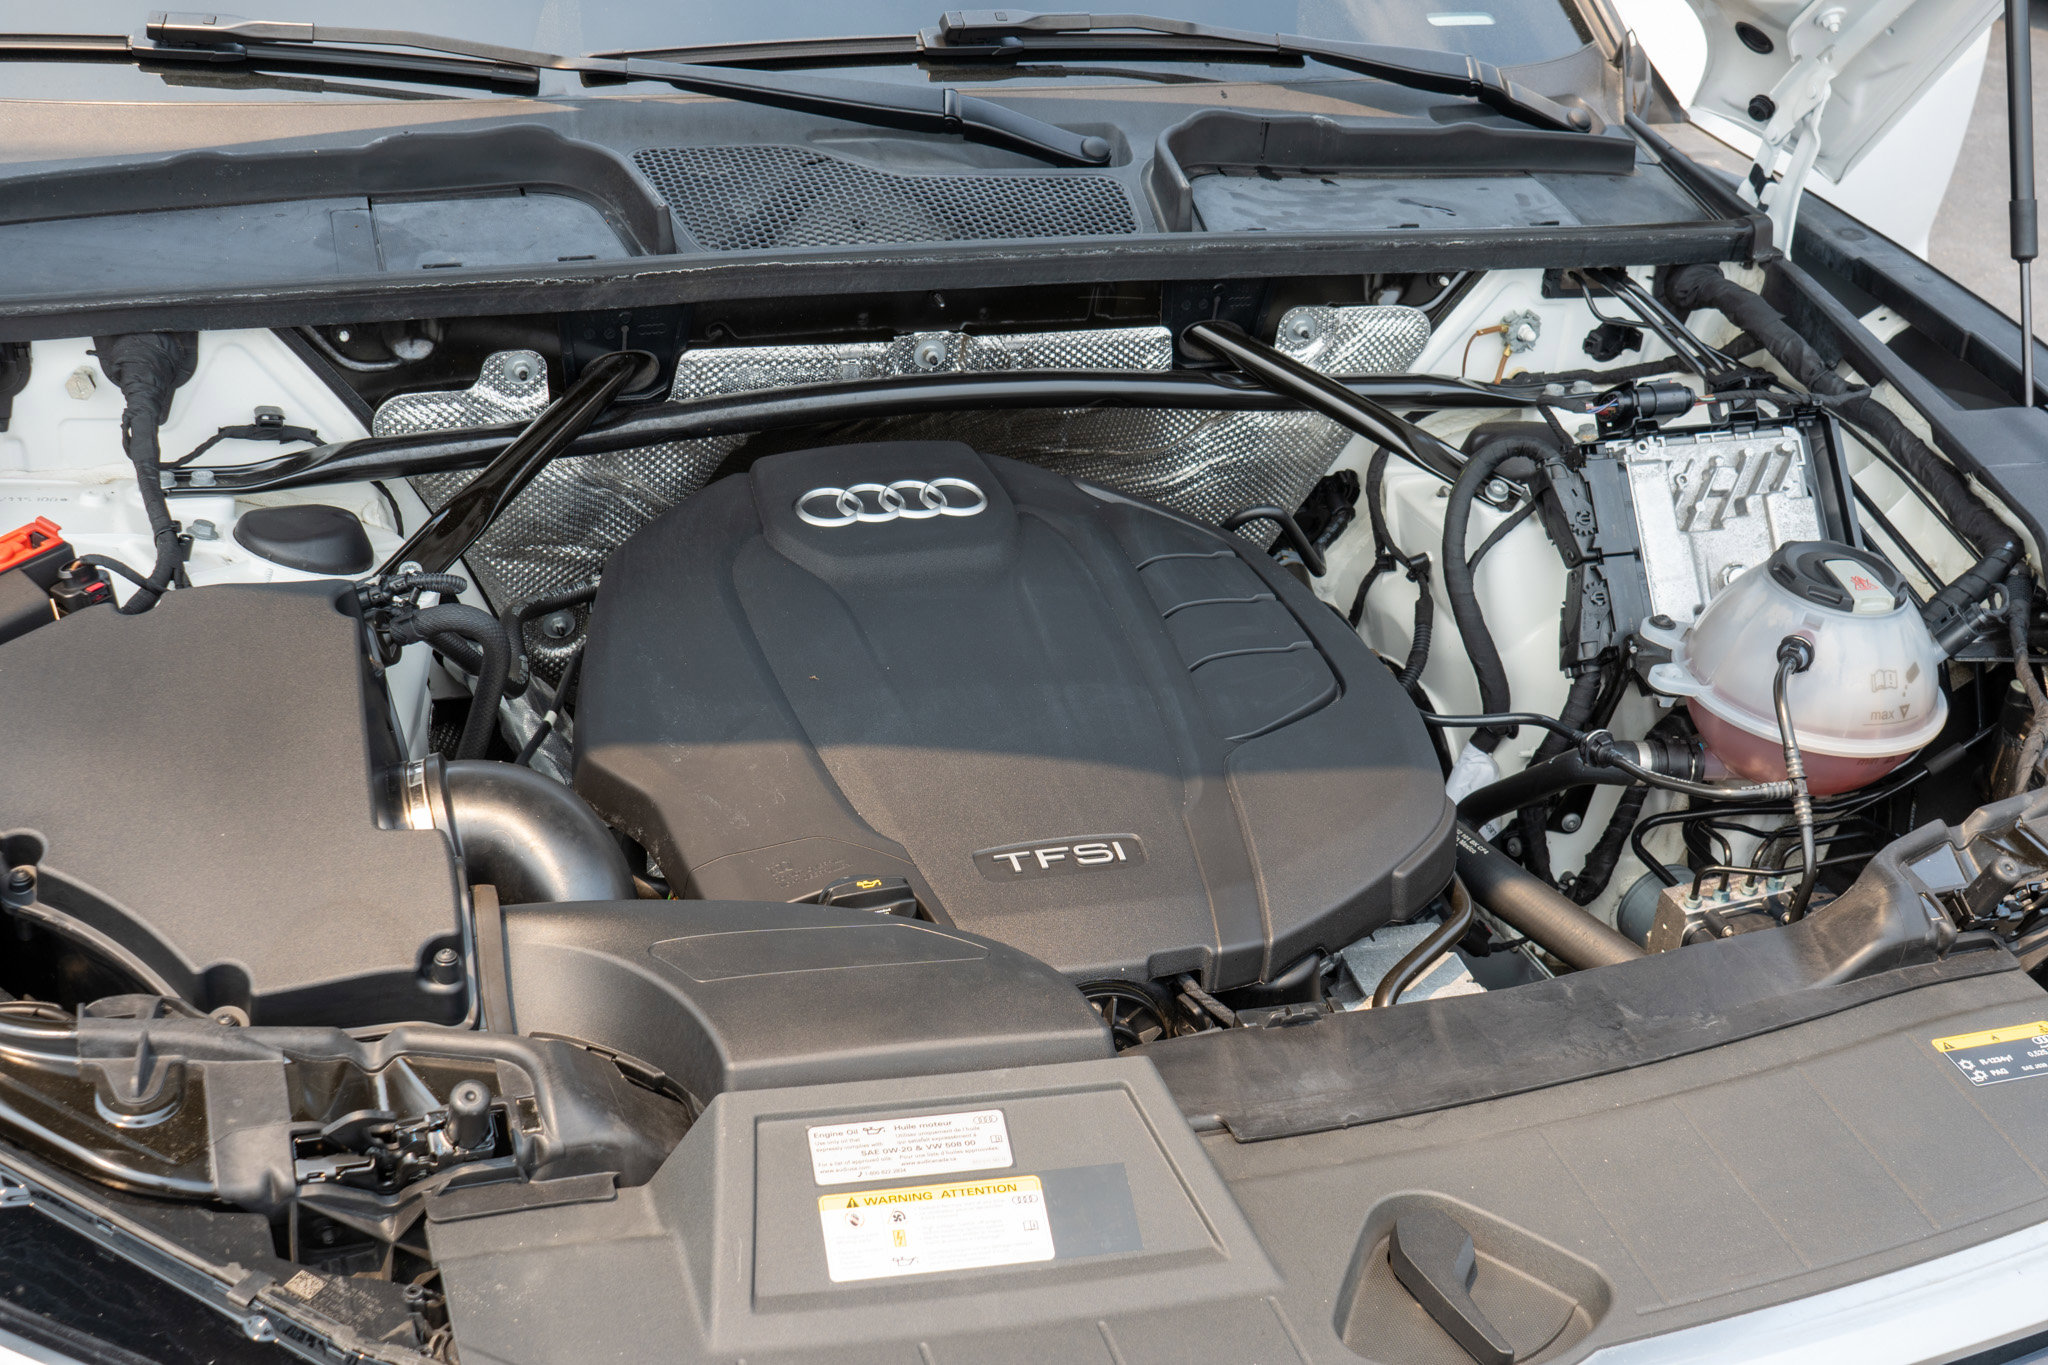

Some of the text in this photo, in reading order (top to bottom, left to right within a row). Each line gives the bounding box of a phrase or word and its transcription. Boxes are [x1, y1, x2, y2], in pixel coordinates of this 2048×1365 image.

[1870, 709, 1895, 721] max
[993, 841, 1127, 873] TFSI
[1979, 1055, 2013, 1066] R-1234yf
[894, 1120, 952, 1131] Huile moteur
[813, 1128, 858, 1139] Engine Oil
[861, 1150, 880, 1158] SAE
[882, 1146, 913, 1155] 0W-20
[926, 1142, 943, 1150] VW
[852, 1157, 880, 1166] approved
[863, 1183, 1018, 1206] WARNING ATTENTION
